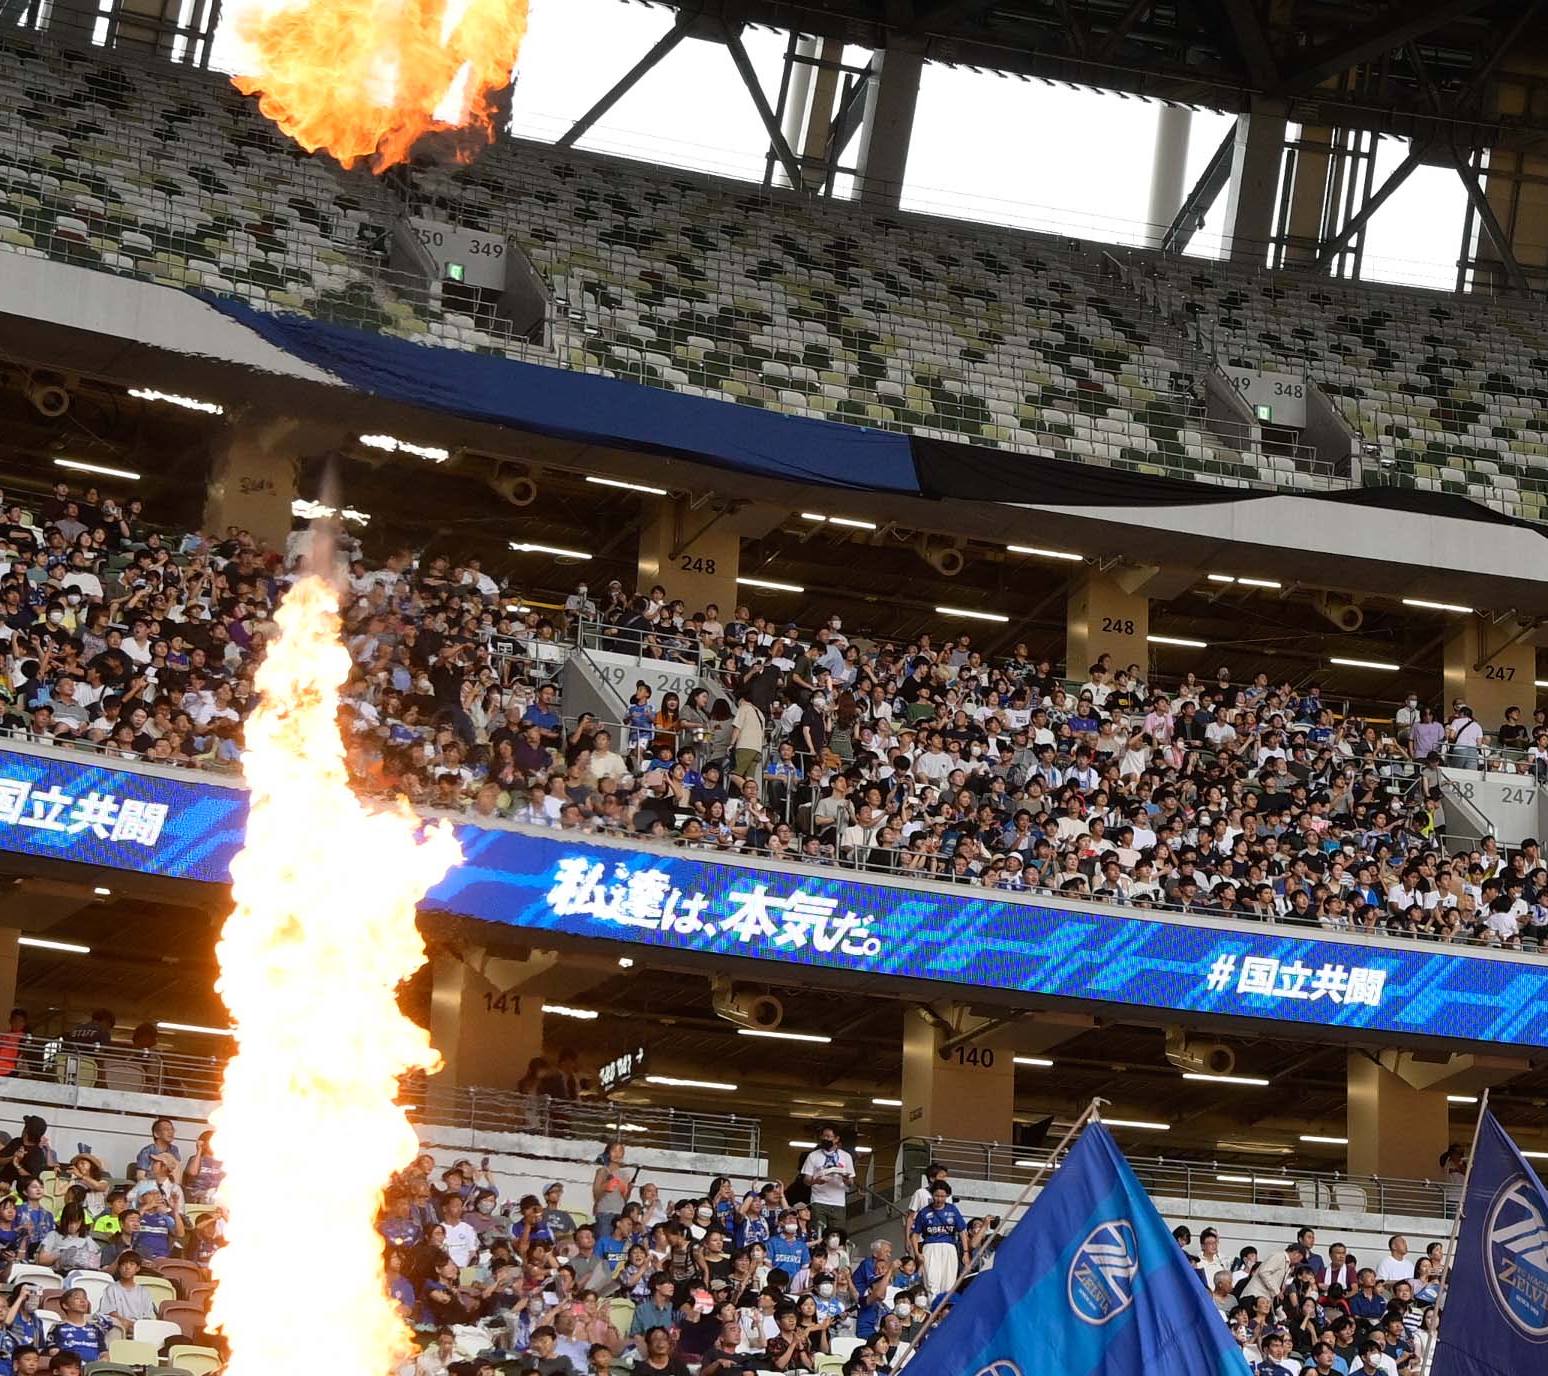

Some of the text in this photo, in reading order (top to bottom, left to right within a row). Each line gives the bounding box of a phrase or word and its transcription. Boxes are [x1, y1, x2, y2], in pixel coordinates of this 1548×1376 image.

[468, 239, 504, 259] 349
[1273, 381, 1304, 400] 348
[680, 555, 717, 576] 248
[1101, 616, 1135, 636] 248
[1484, 664, 1517, 682] 247
[656, 672, 699, 697] 248
[1501, 786, 1536, 806] 247
[546, 857, 882, 959] 私達は、本気だ。
[1207, 953, 1386, 1008] #国立共闘
[483, 992, 522, 1015] 141
[954, 1046, 994, 1069] 140
